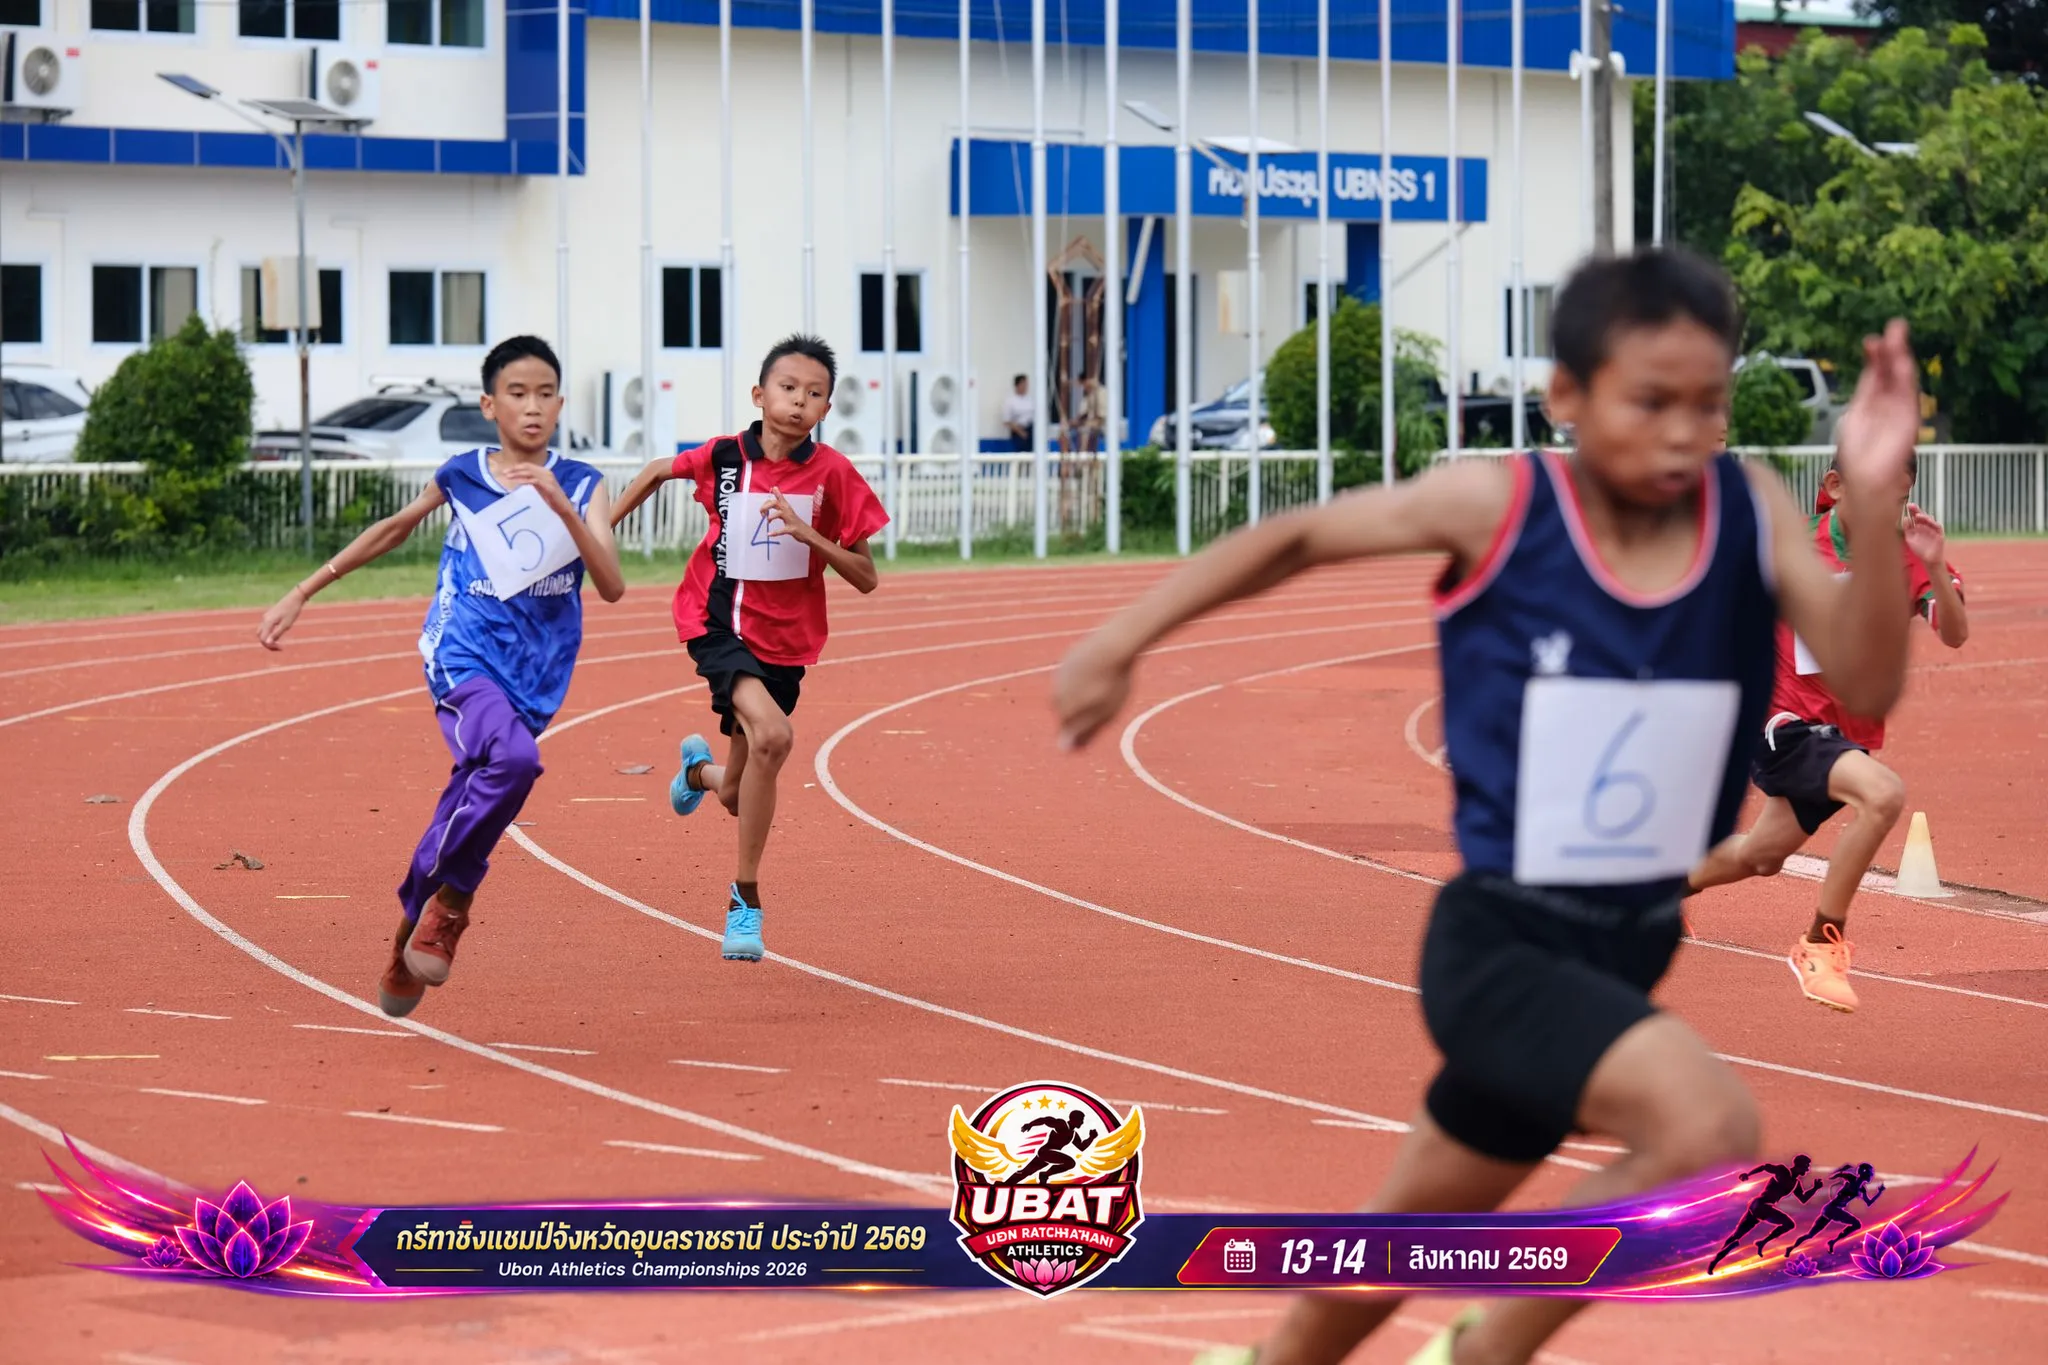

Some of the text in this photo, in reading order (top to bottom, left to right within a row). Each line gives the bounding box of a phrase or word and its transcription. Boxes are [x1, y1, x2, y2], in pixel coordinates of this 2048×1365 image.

[1422, 169, 1436, 202] 1
[496, 505, 545, 572] 5
[750, 508, 781, 561] 4
[1583, 708, 1658, 842] 6
